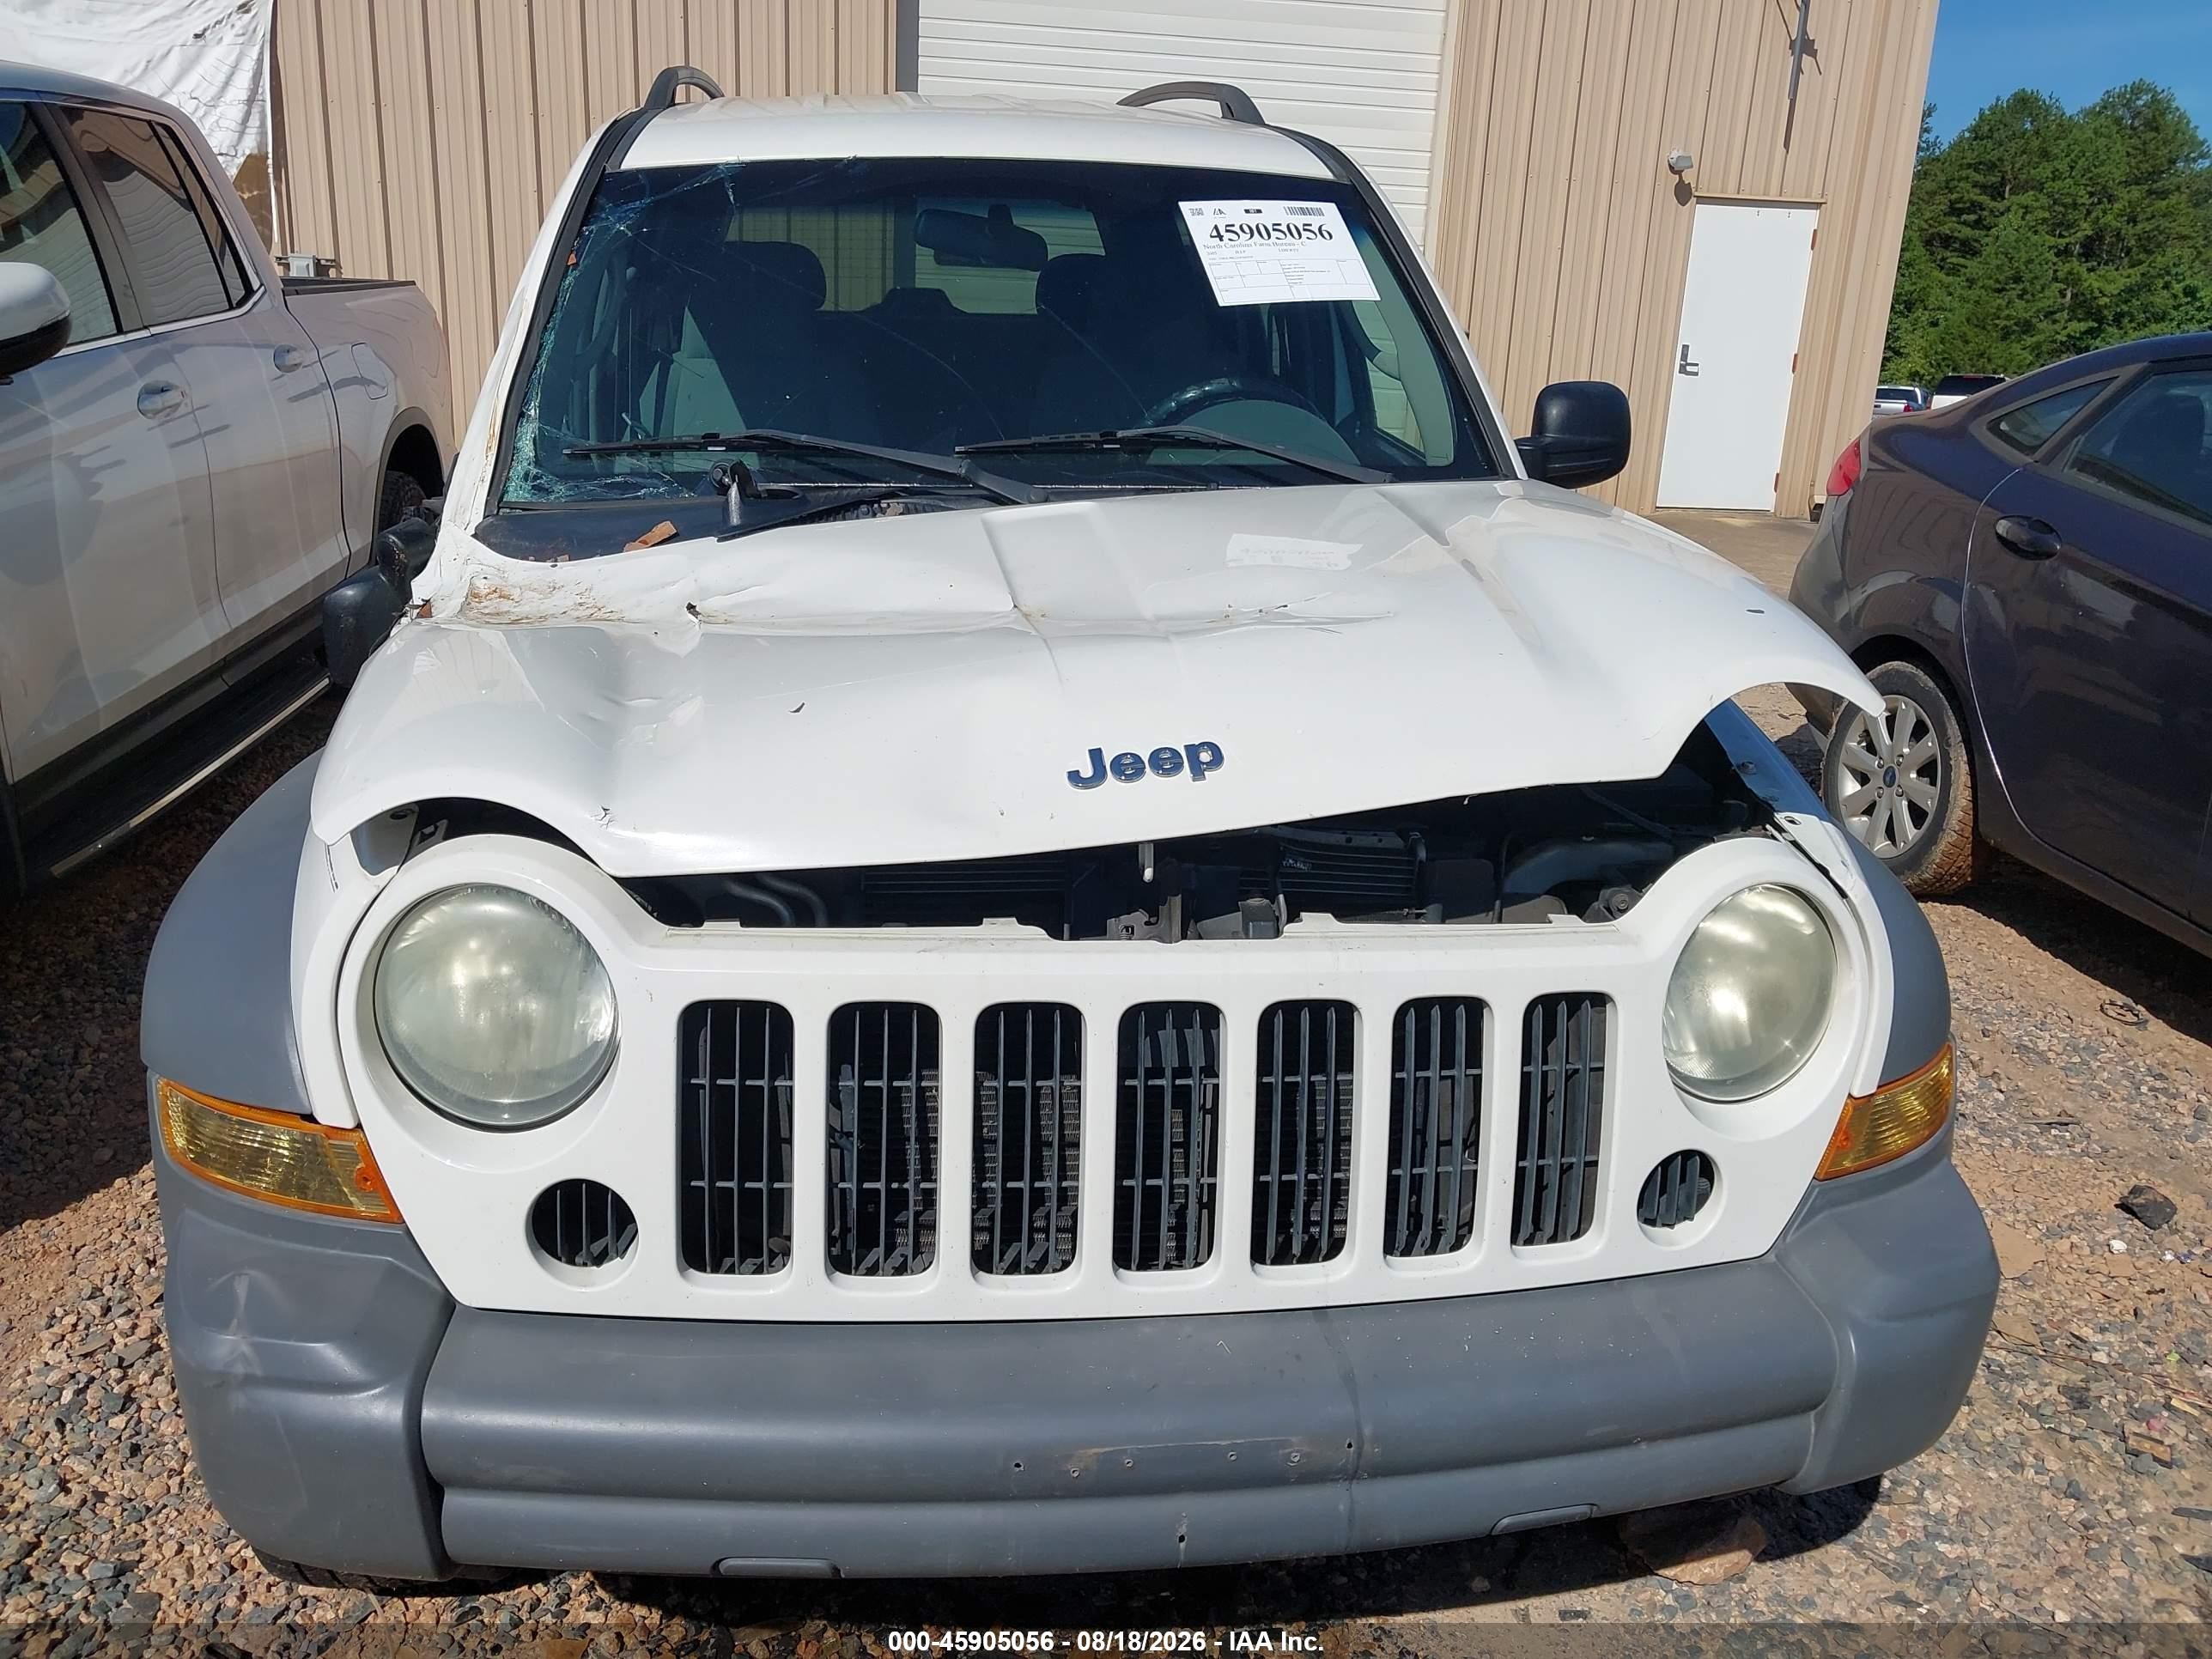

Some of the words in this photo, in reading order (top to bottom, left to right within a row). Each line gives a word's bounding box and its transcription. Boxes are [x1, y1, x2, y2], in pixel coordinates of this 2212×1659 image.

[1209, 223, 1334, 242] 45905056
[1224, 241, 1253, 250] Carolina
[1066, 741, 1224, 790] Jeep
